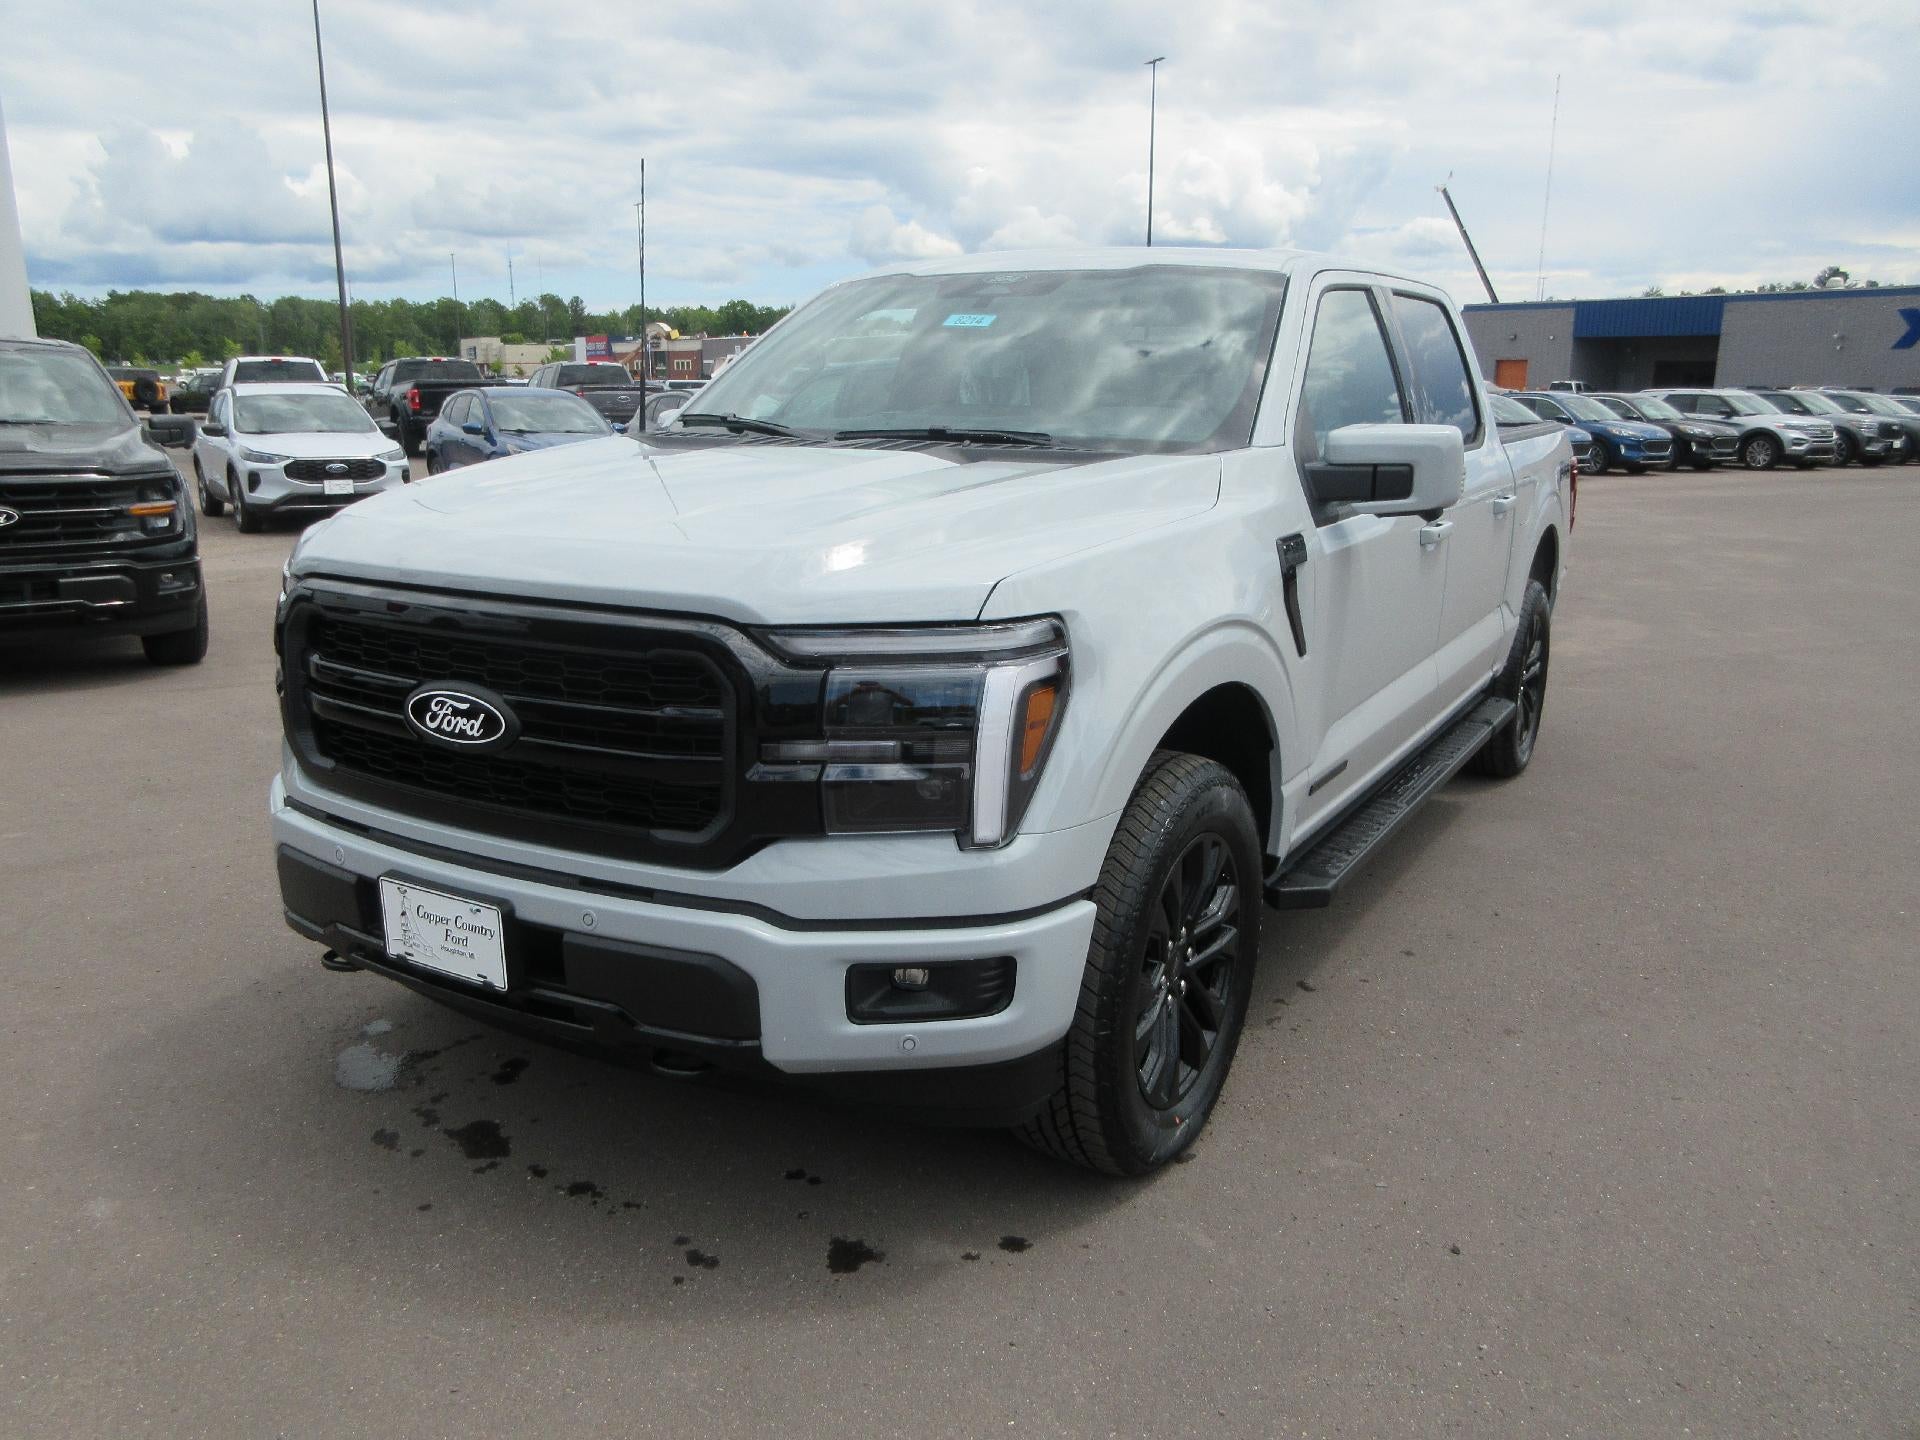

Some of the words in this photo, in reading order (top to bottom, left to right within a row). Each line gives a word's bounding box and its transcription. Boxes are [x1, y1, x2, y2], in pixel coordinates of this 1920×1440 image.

[425, 696, 485, 737] Ford
[416, 904, 452, 926] Copper
[454, 915, 496, 941] Country
[444, 929, 468, 947] Ford
